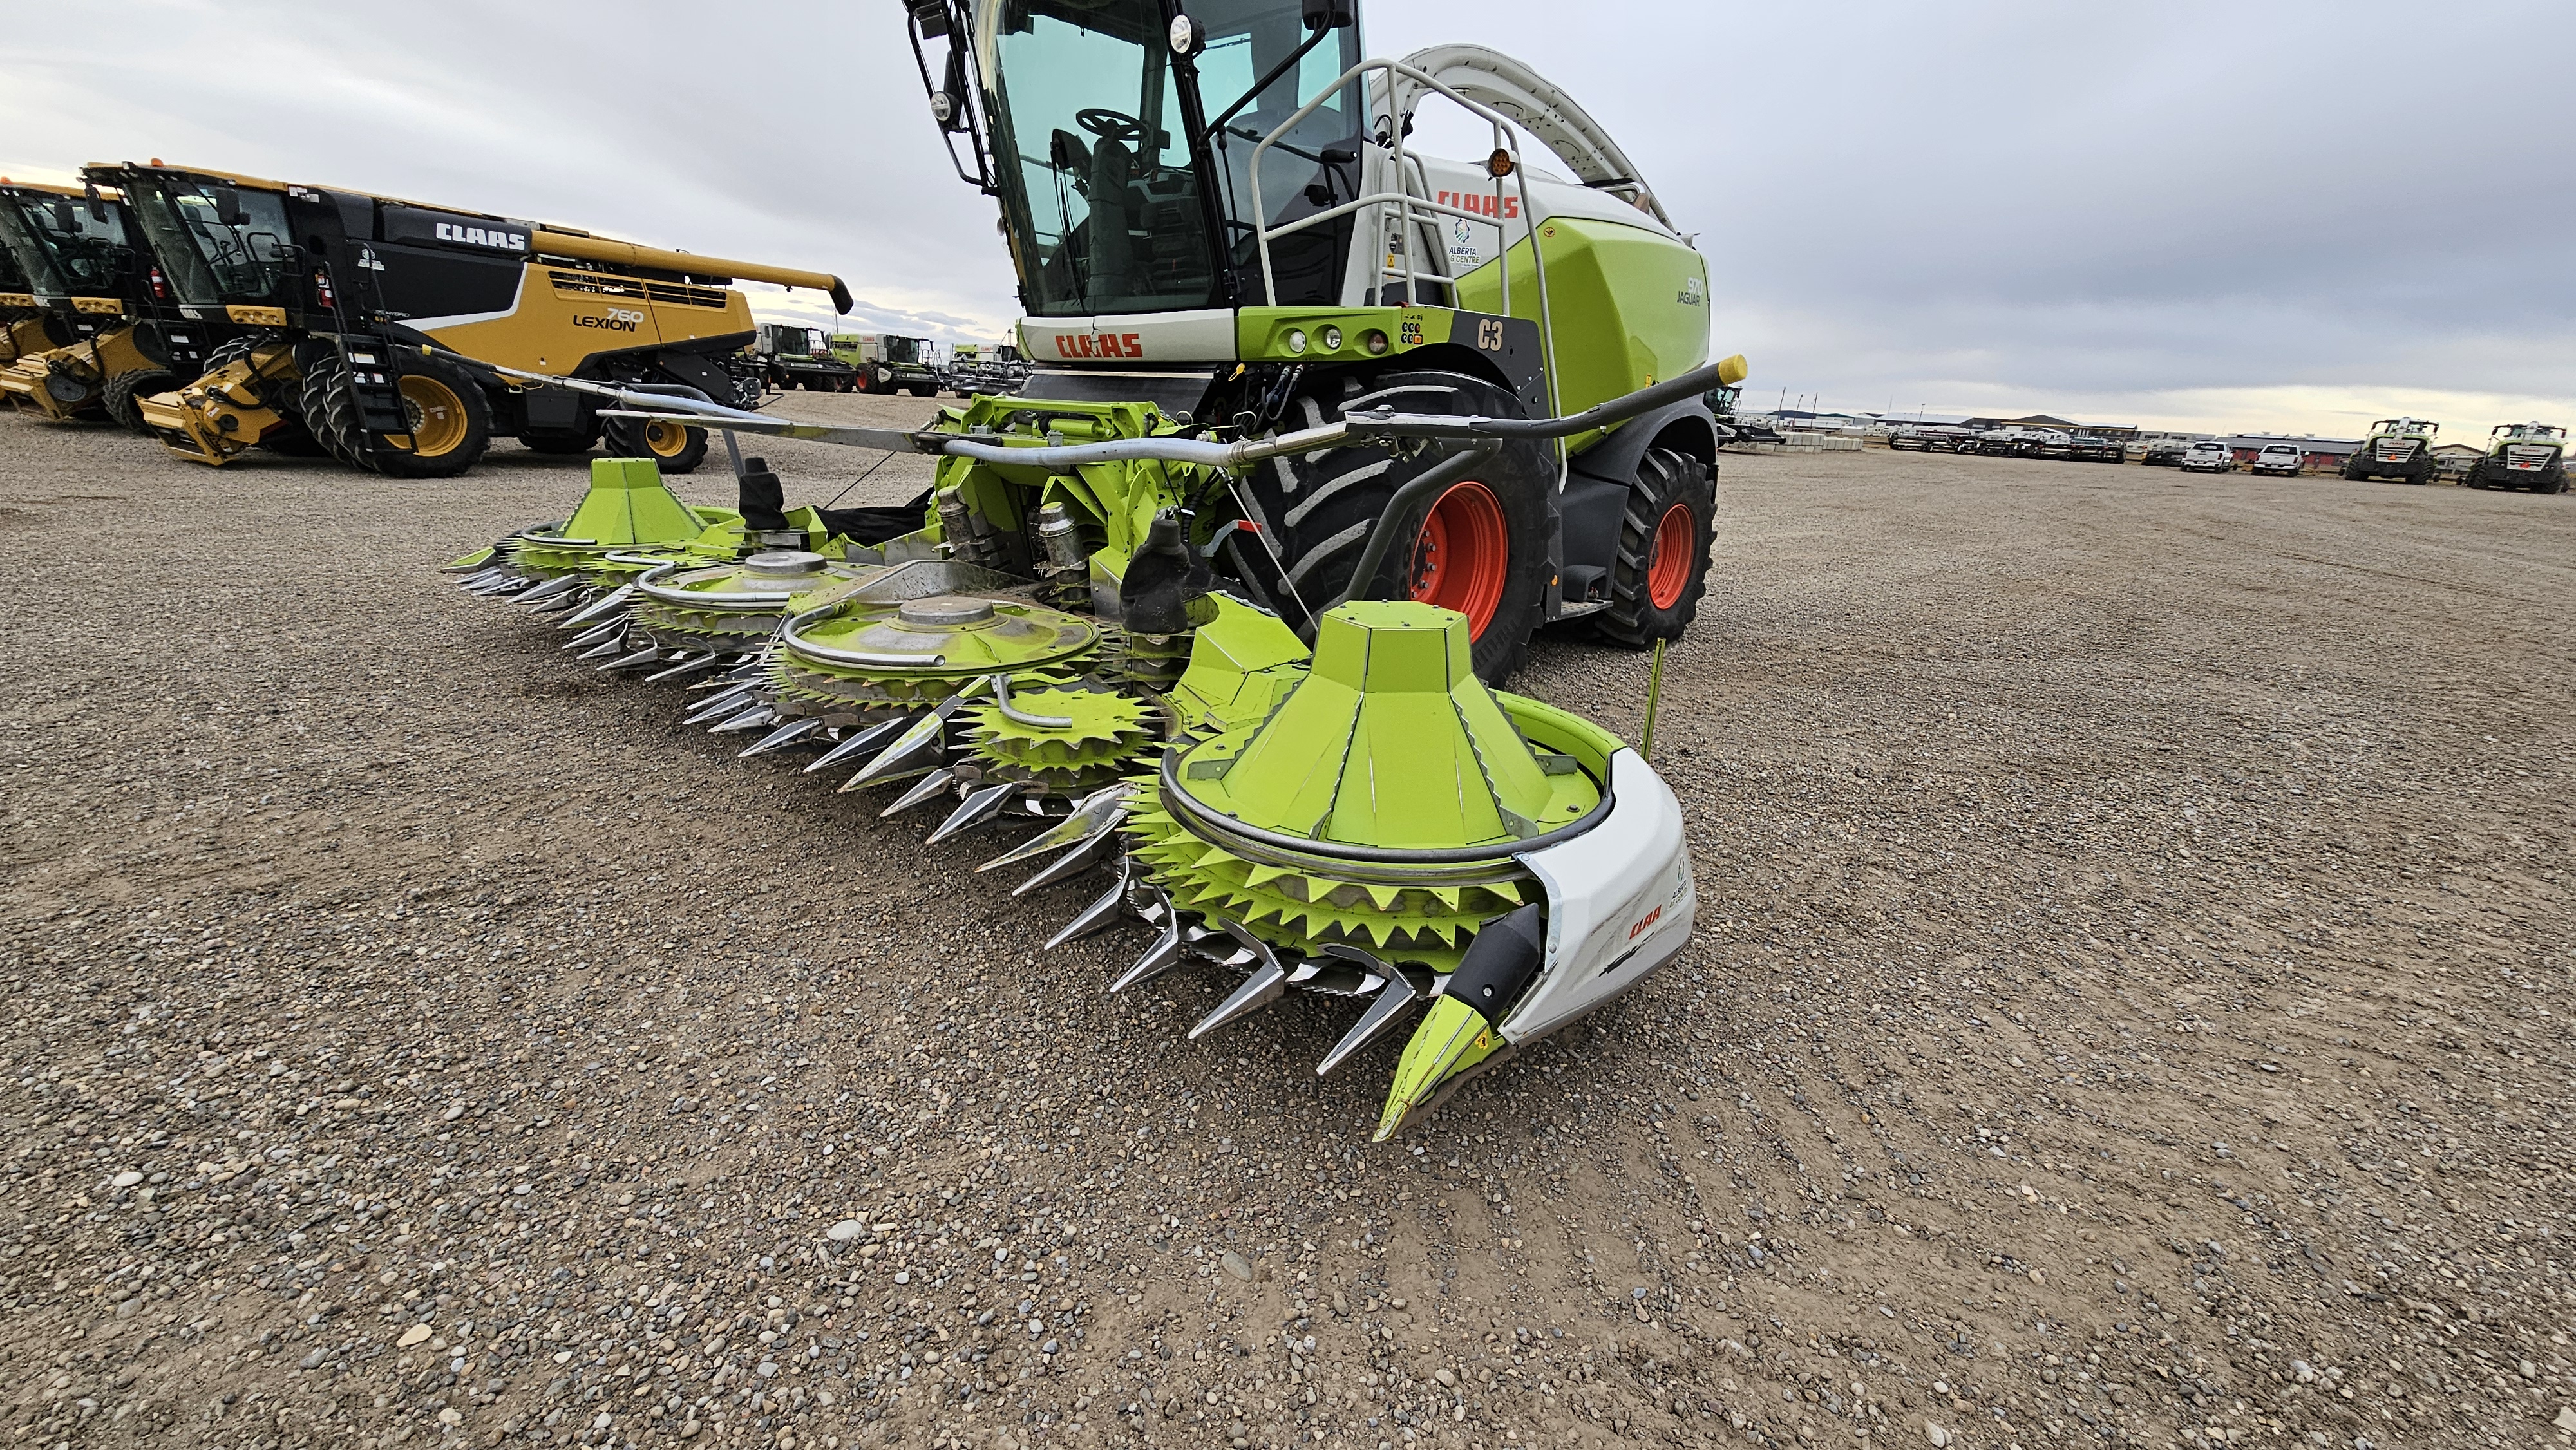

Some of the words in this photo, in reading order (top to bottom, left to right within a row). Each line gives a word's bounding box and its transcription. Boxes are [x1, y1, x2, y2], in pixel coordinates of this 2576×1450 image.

[436, 223, 525, 250] CLAAS
[1449, 246, 1477, 256] ALBERTA
[1456, 255, 1480, 264] CENTRE
[1688, 277, 1703, 296] 970
[1677, 290, 1700, 306] JAGUAR
[573, 314, 636, 332] LEXION
[607, 307, 644, 323] 760
[1477, 318, 1503, 352] C3
[1055, 333, 1143, 358] CLAAS
